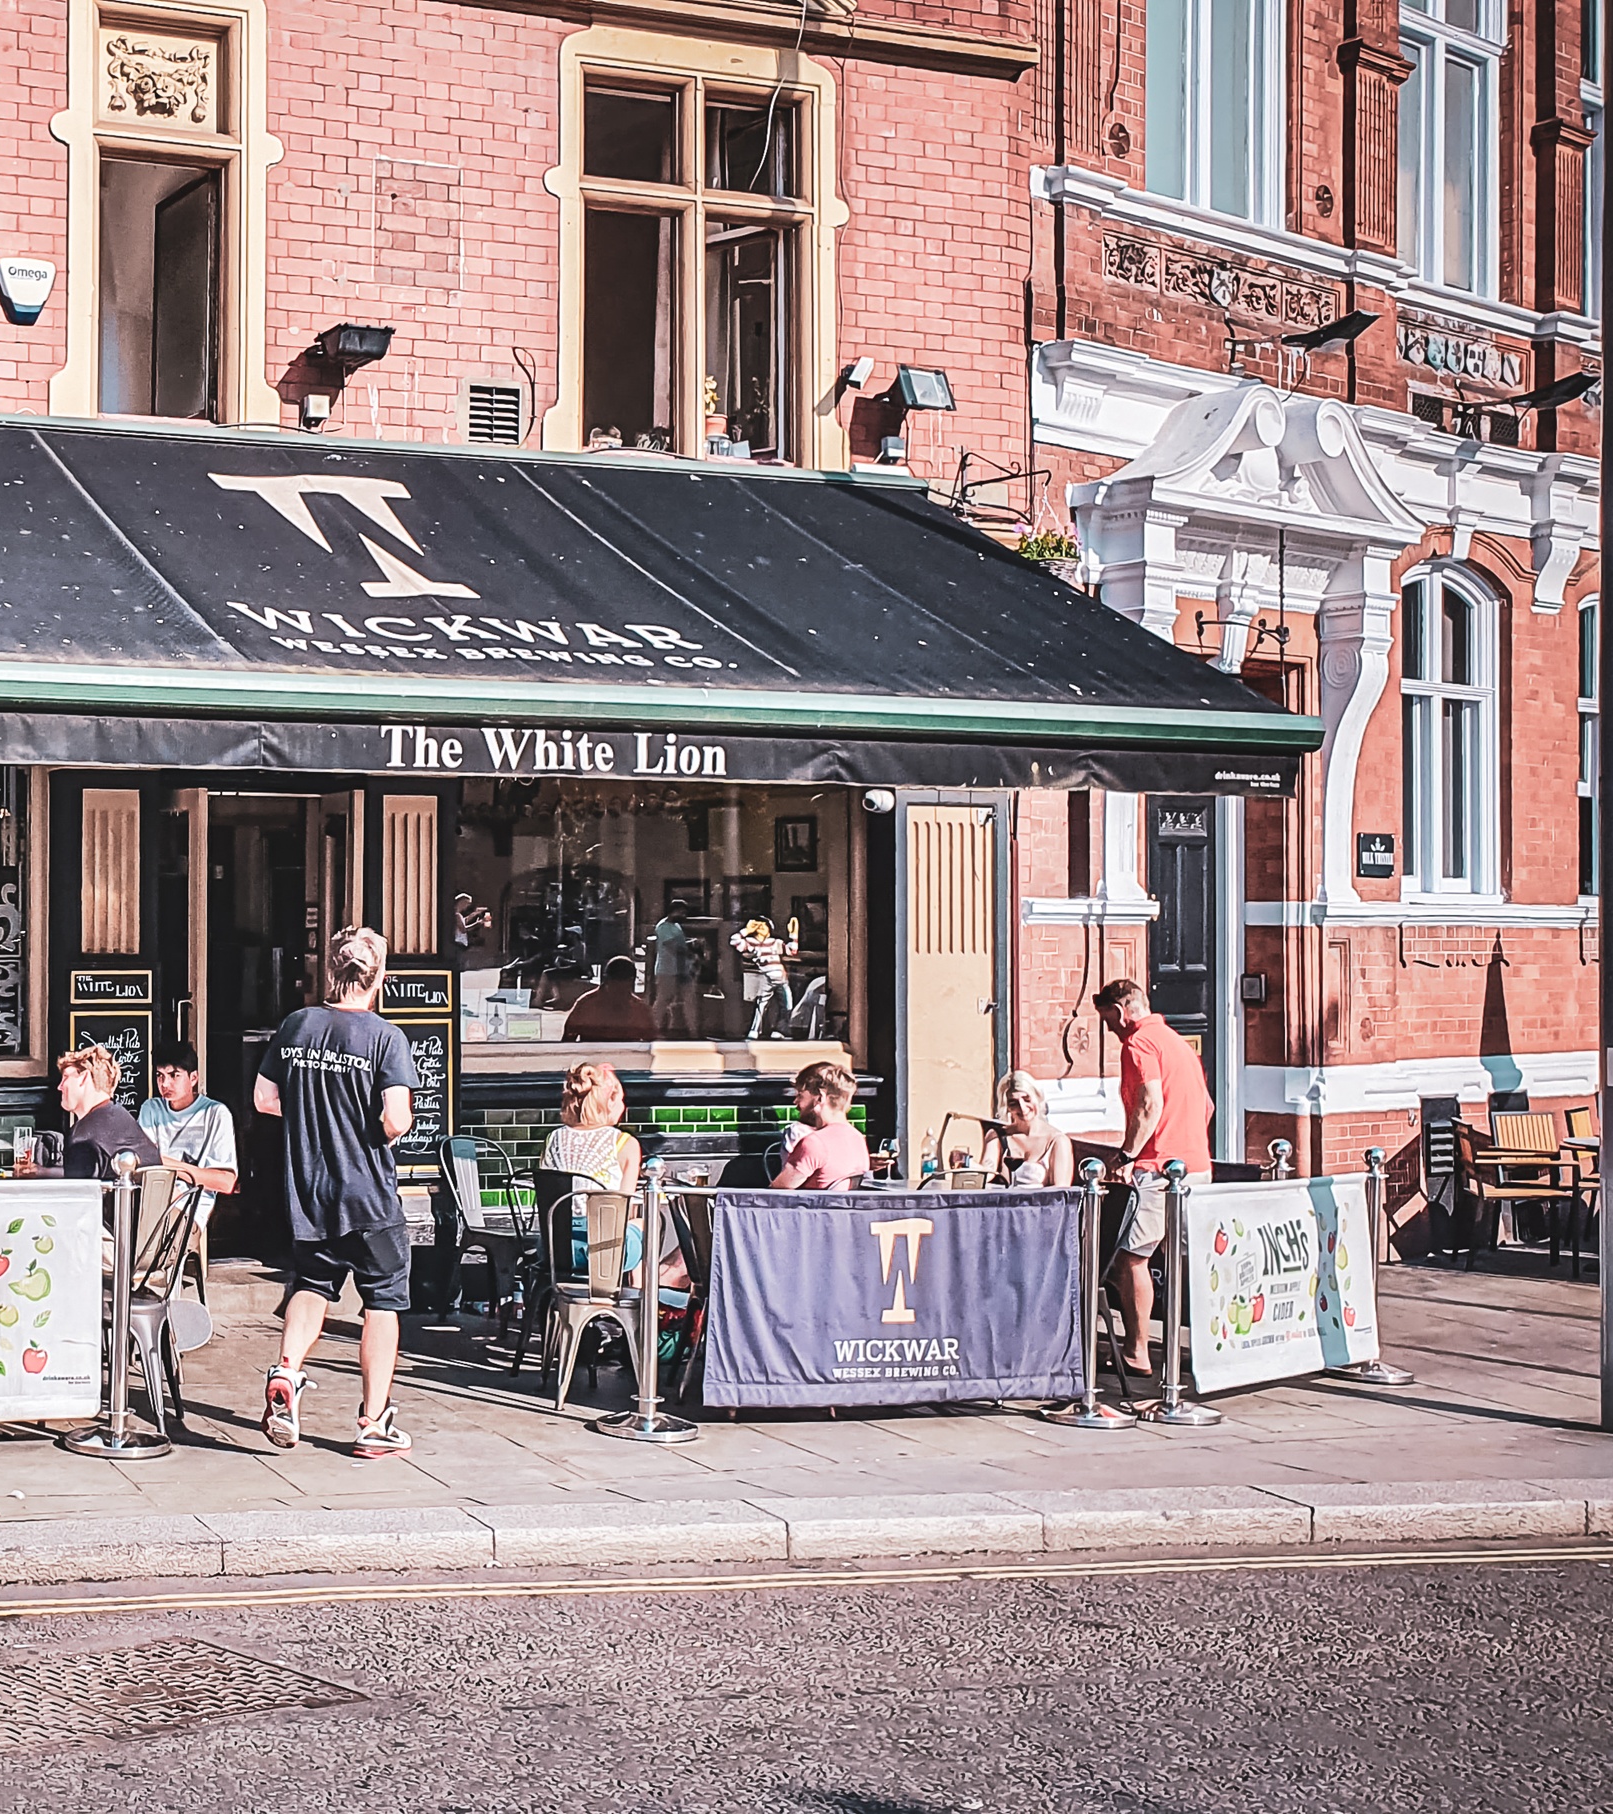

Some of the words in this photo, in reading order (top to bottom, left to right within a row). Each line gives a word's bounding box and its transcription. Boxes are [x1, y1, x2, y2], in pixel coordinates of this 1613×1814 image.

[8, 266, 48, 281] Omega
[226, 601, 704, 651] WICKWAR
[270, 636, 449, 660] WESSEX
[454, 647, 655, 668] BREWING
[664, 655, 739, 670] CO.
[380, 724, 463, 769] The
[481, 727, 615, 772] White
[633, 732, 728, 776] Lion
[123, 1027, 141, 1049] Pub
[428, 1035, 444, 1056] Pub
[307, 1048, 321, 1060] IN
[322, 1049, 373, 1072] BRISTOL
[833, 1337, 960, 1363] WICKWAR
[832, 1367, 882, 1379] WESSEX
[885, 1365, 939, 1378] BREWING
[942, 1364, 959, 1376] CO.
